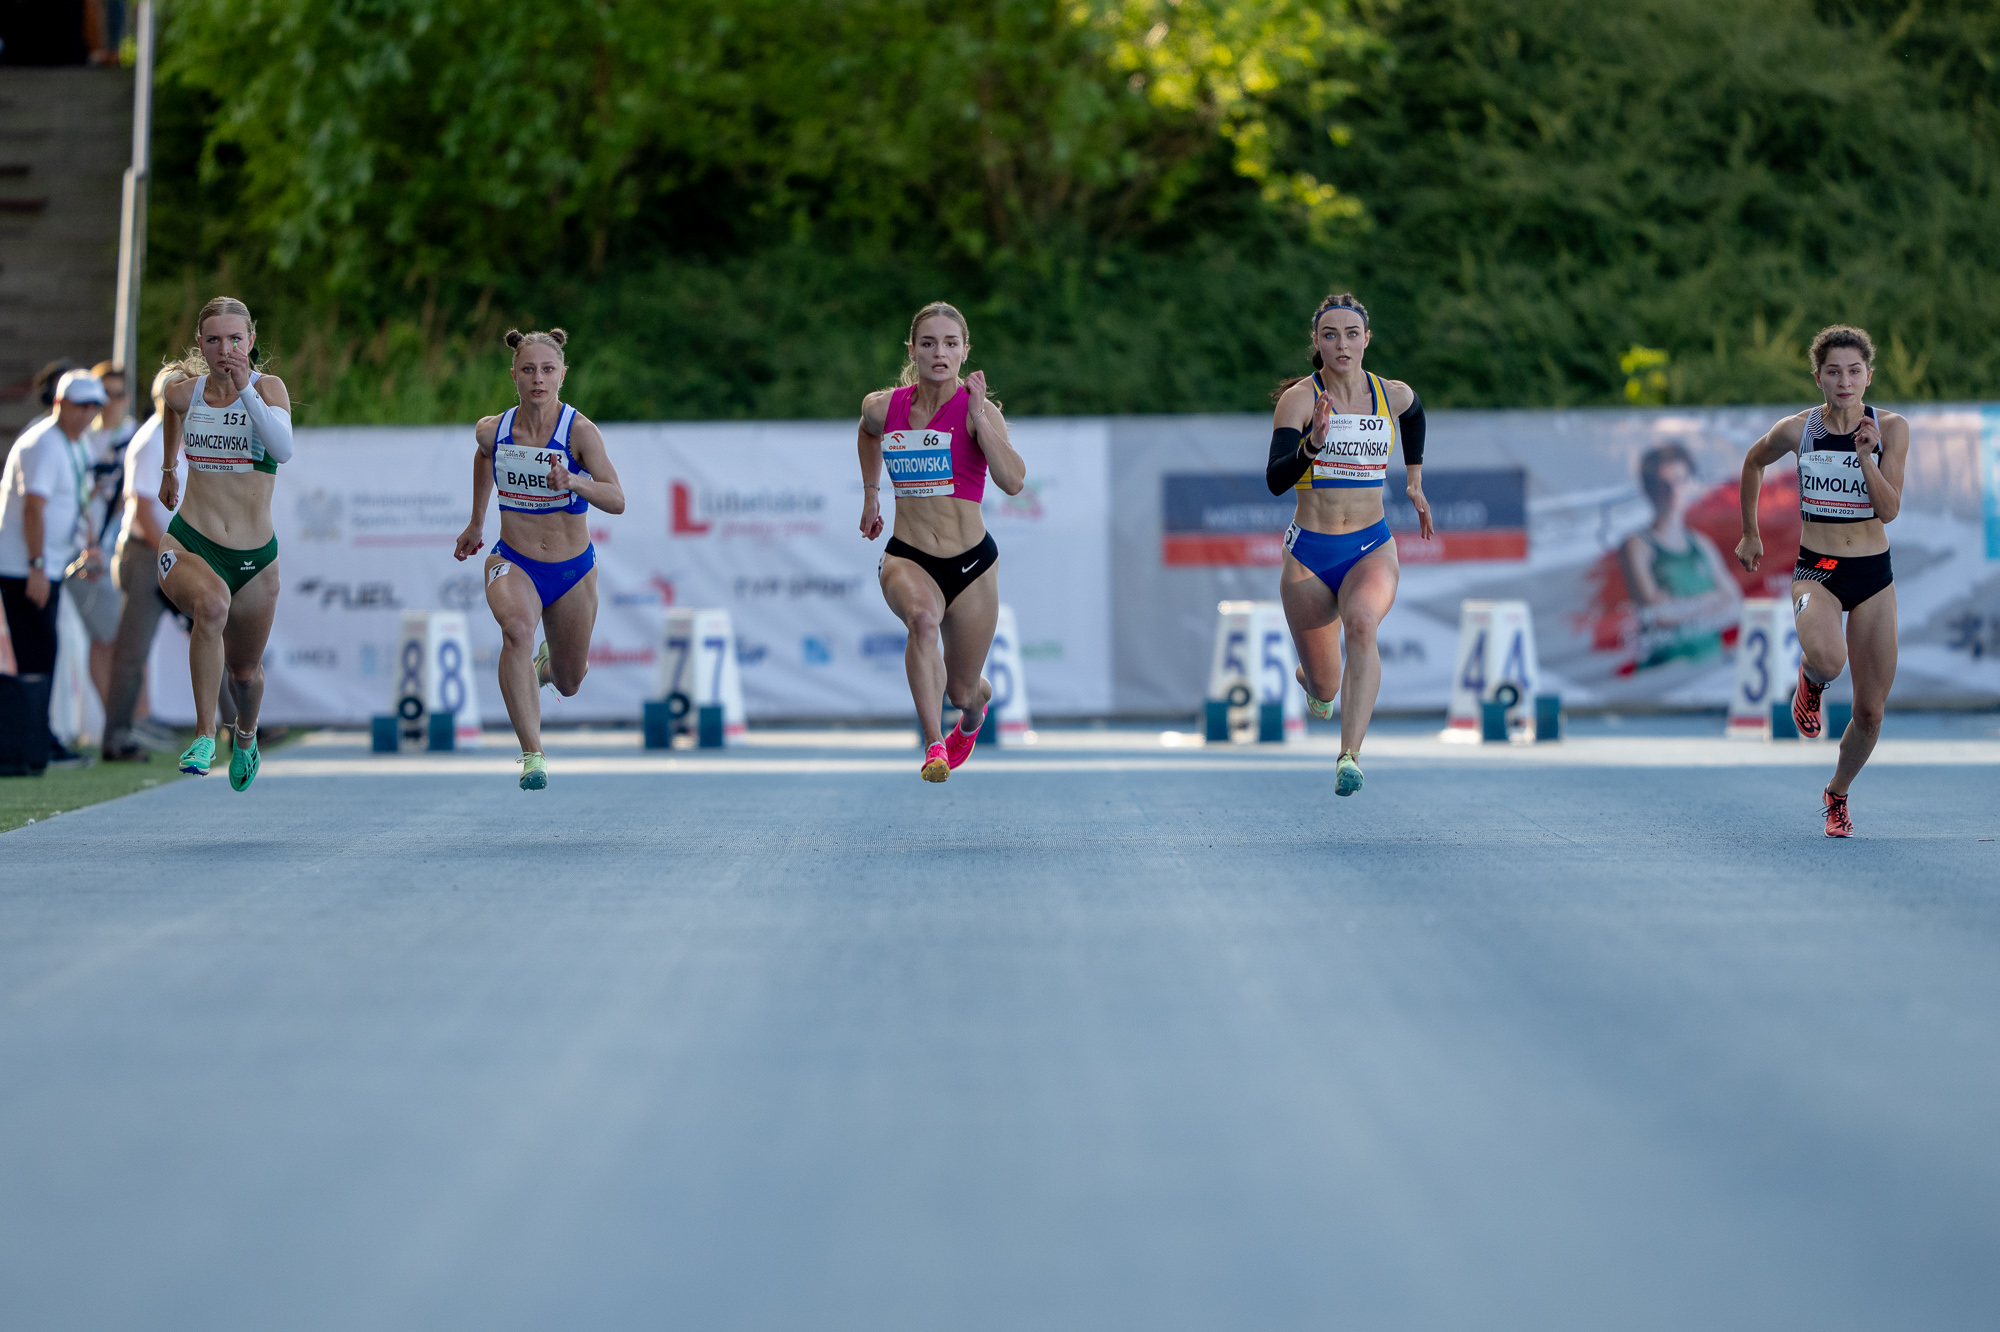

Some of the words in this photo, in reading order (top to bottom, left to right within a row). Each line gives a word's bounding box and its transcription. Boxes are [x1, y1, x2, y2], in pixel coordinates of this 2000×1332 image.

[185, 432, 249, 451] ADAMCZEWSKA
[223, 412, 246, 426] 151
[923, 433, 939, 446] 66
[1359, 418, 1383, 431] 507
[507, 471, 550, 490] BĄBE
[886, 456, 950, 474] PIOTROWSKA
[160, 553, 172, 573] 8
[492, 563, 505, 579] 7
[402, 638, 424, 690] 8
[439, 638, 466, 713] 8
[668, 637, 690, 696] 7
[704, 637, 725, 705] 7
[987, 636, 1014, 708] 6
[1224, 631, 1246, 677] 5
[1263, 631, 1288, 702] 5
[1462, 630, 1486, 702] 4
[1505, 630, 1529, 690] 4
[1743, 629, 1769, 702] 3
